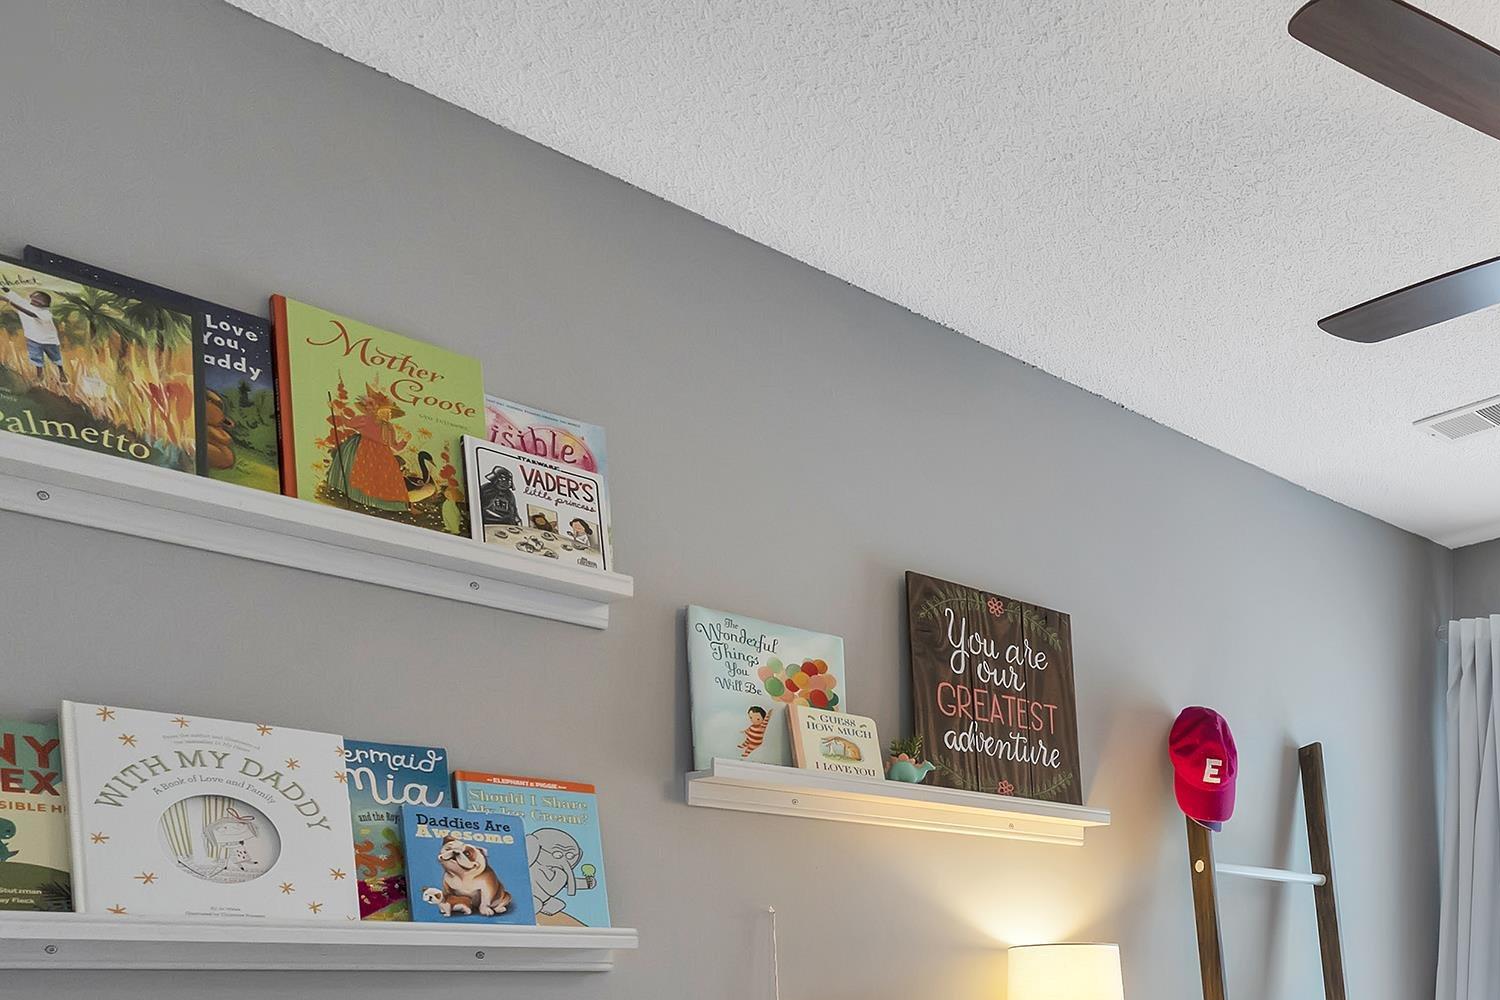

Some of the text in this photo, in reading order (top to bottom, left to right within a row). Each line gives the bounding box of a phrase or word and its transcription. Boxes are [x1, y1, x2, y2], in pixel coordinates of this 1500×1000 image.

[205, 314, 258, 342] Love
[306, 320, 445, 383] Mother
[204, 354, 262, 381] addy
[390, 379, 476, 417] Goose
[490, 425, 577, 464] isible
[520, 465, 594, 502] VADER'S
[523, 487, 596, 513] little princess
[724, 618, 739, 629] The
[695, 623, 778, 653] Wonderful
[945, 608, 1048, 674] You are
[710, 641, 759, 667] Things
[725, 661, 749, 677] You
[977, 660, 1025, 691] our
[715, 677, 762, 695] Will Be
[820, 714, 856, 727] GUESS
[937, 682, 1058, 735] GREATEST
[807, 721, 872, 739] HOW MUCH
[944, 720, 1061, 769] adventure
[344, 749, 443, 772] ermaid
[816, 761, 876, 777] I LOVE YOU
[1203, 758, 1222, 784] E
[0, 768, 60, 797] EX
[94, 750, 332, 831] WITH MY DADDY
[160, 777, 187, 790] Book
[200, 775, 223, 783] Love
[226, 779, 245, 788] and
[246, 784, 276, 803] Family
[0, 800, 47, 812] SIBLE
[468, 789, 588, 809] Should I Share
[358, 812, 400, 825] and the Roy
[416, 814, 511, 833] Daddies Are
[416, 824, 515, 844] Awesome
